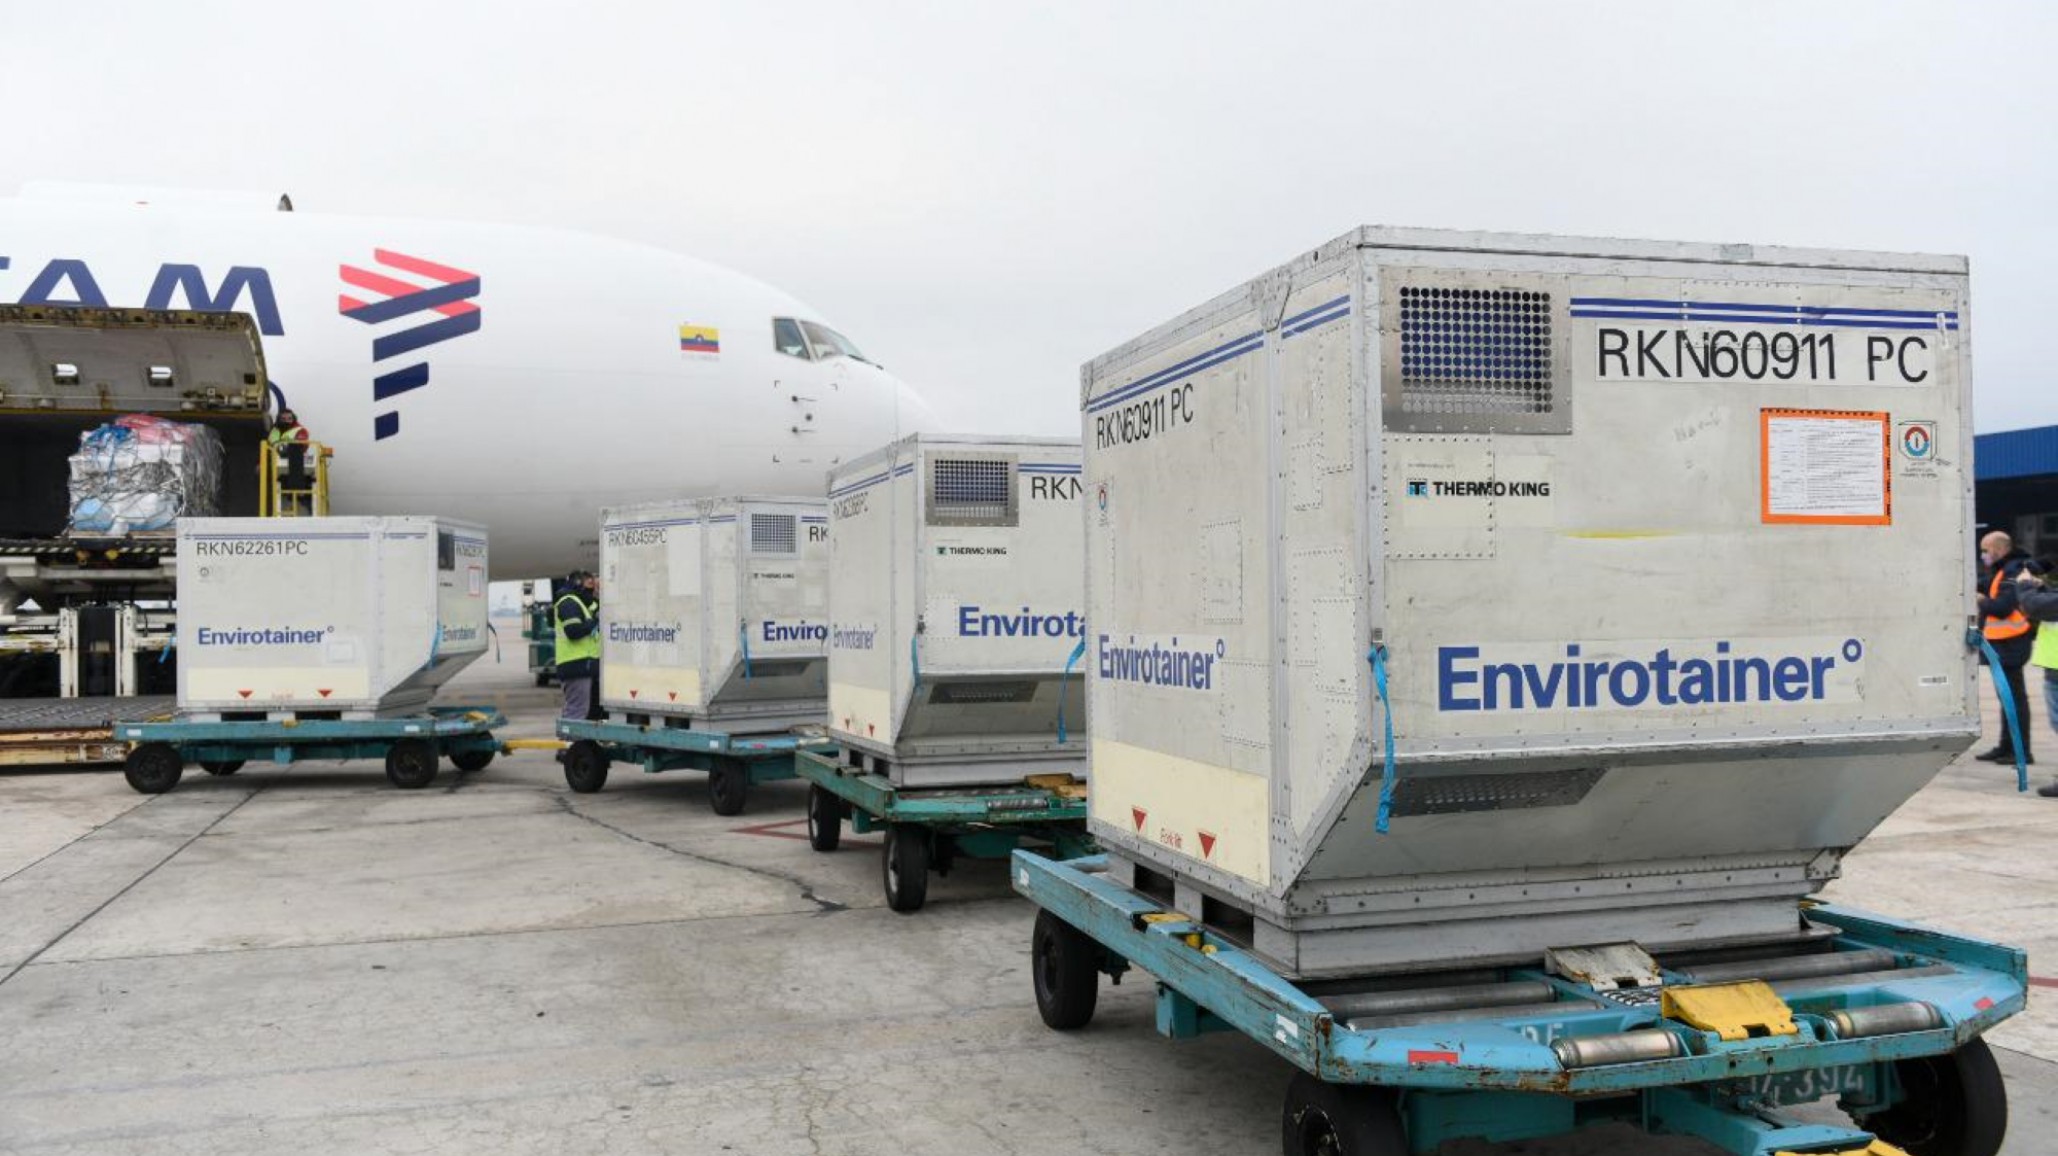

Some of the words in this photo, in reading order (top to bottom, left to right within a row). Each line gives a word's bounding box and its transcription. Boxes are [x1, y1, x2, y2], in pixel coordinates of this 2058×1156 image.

[1599, 328, 1837, 380] RKN60911
[1867, 335, 1929, 383] PC
[1097, 394, 1165, 451] RKN60911
[1171, 382, 1194, 428] PC
[1433, 481, 1506, 497] THERMO
[1509, 482, 1550, 497] KING
[196, 540, 309, 556] RKN62261PC
[986, 546, 1007, 555] KING
